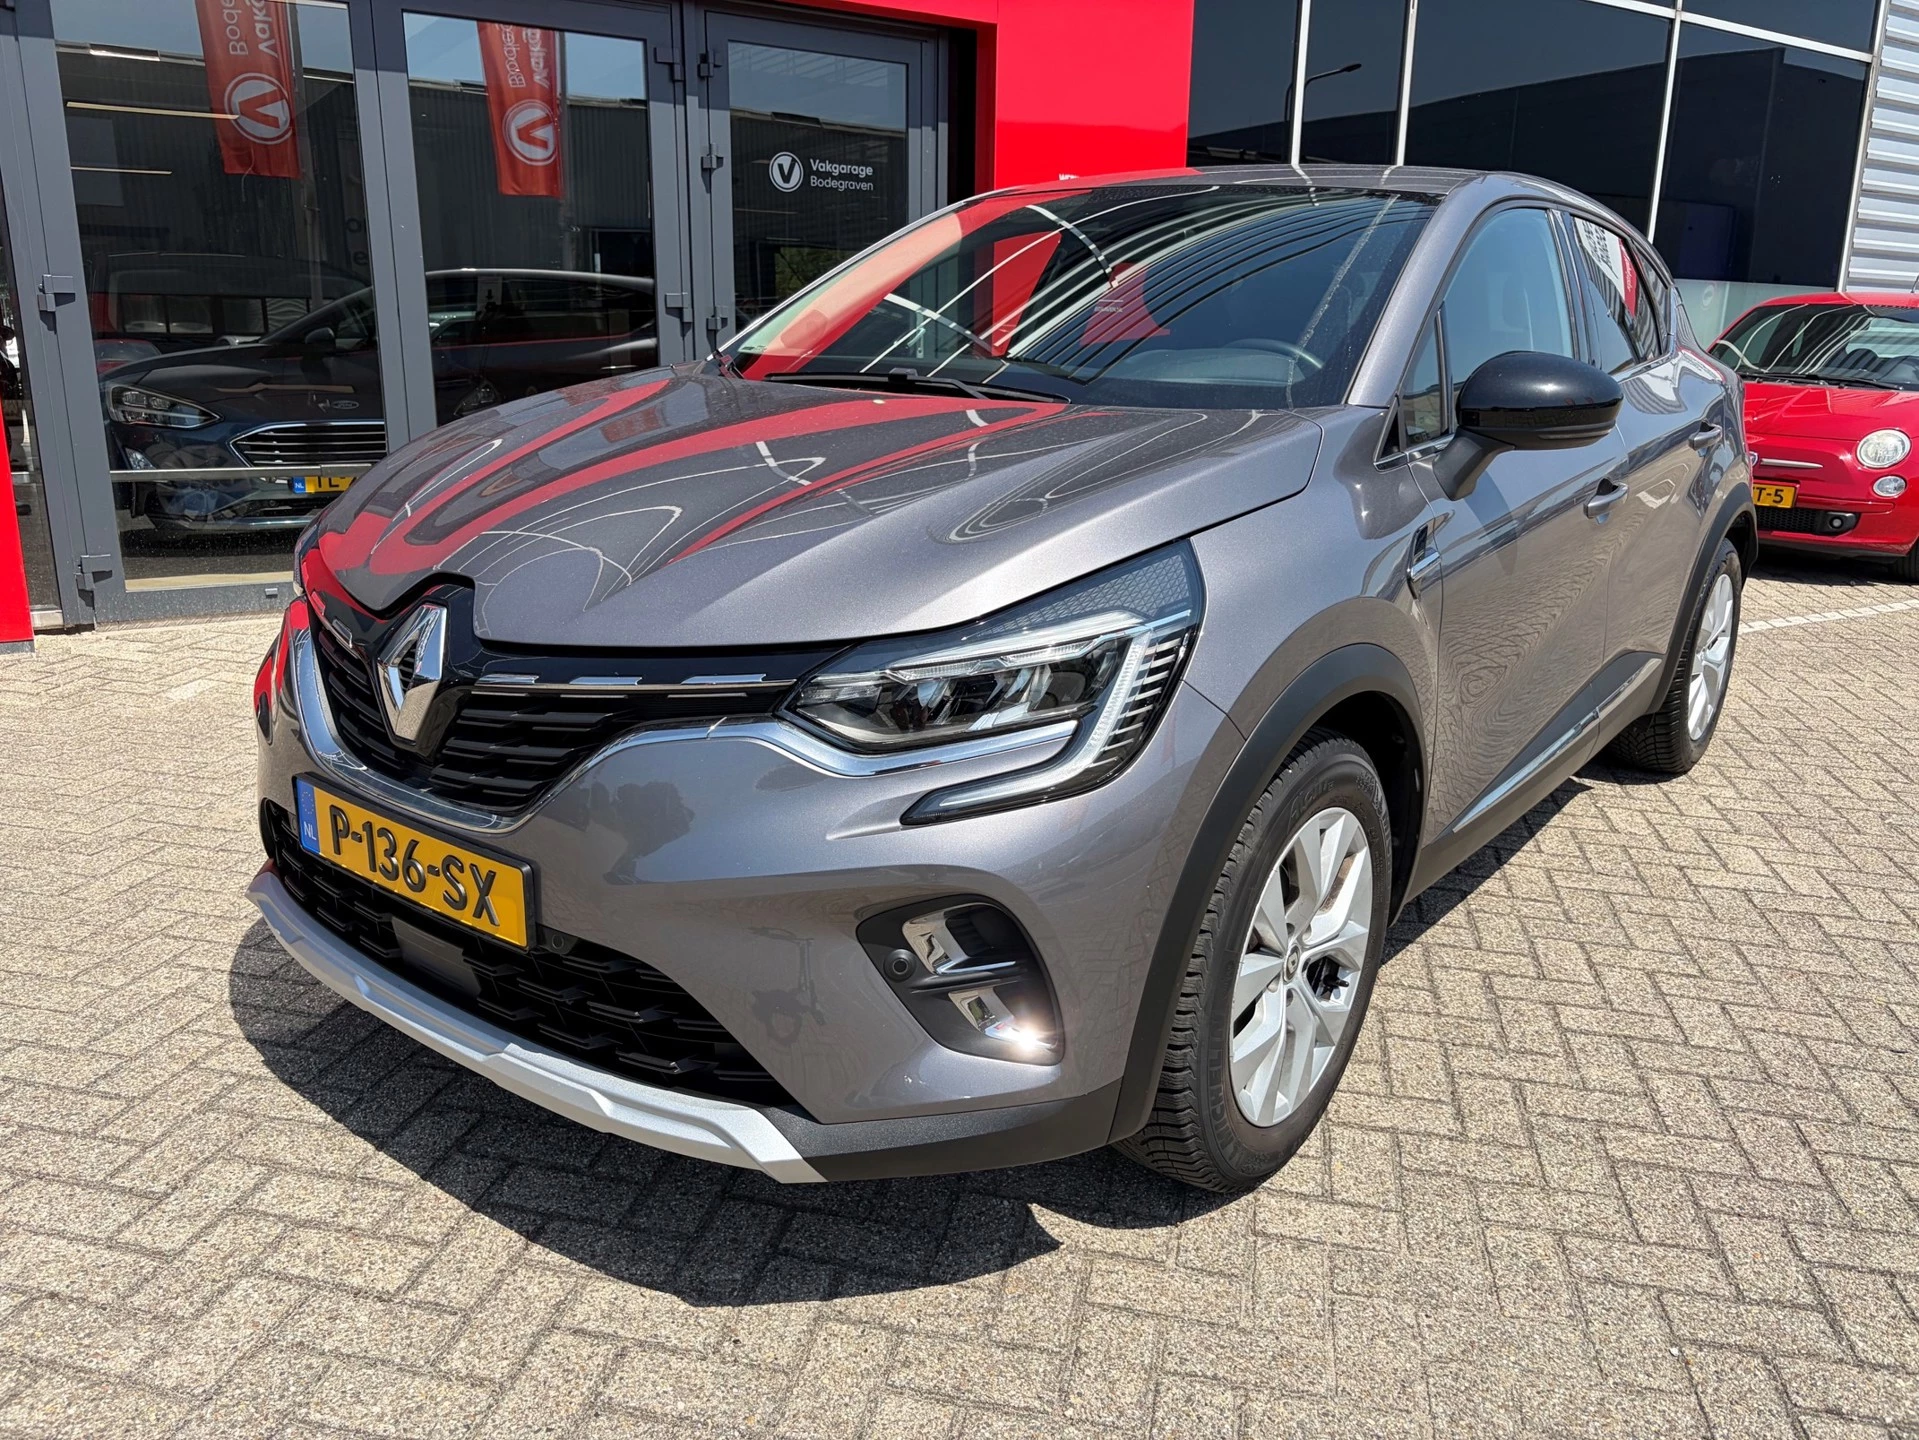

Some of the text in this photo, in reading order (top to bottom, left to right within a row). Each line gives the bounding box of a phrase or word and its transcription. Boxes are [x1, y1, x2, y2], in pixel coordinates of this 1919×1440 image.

[775, 157, 799, 186] V
[810, 159, 874, 178] Vakgarage
[810, 176, 874, 191] Bodegraven
[1753, 486, 1784, 504] T-5
[303, 821, 316, 841] NL
[329, 804, 500, 926] P-136-SX
[1208, 1016, 1237, 1155] MICHELIN
